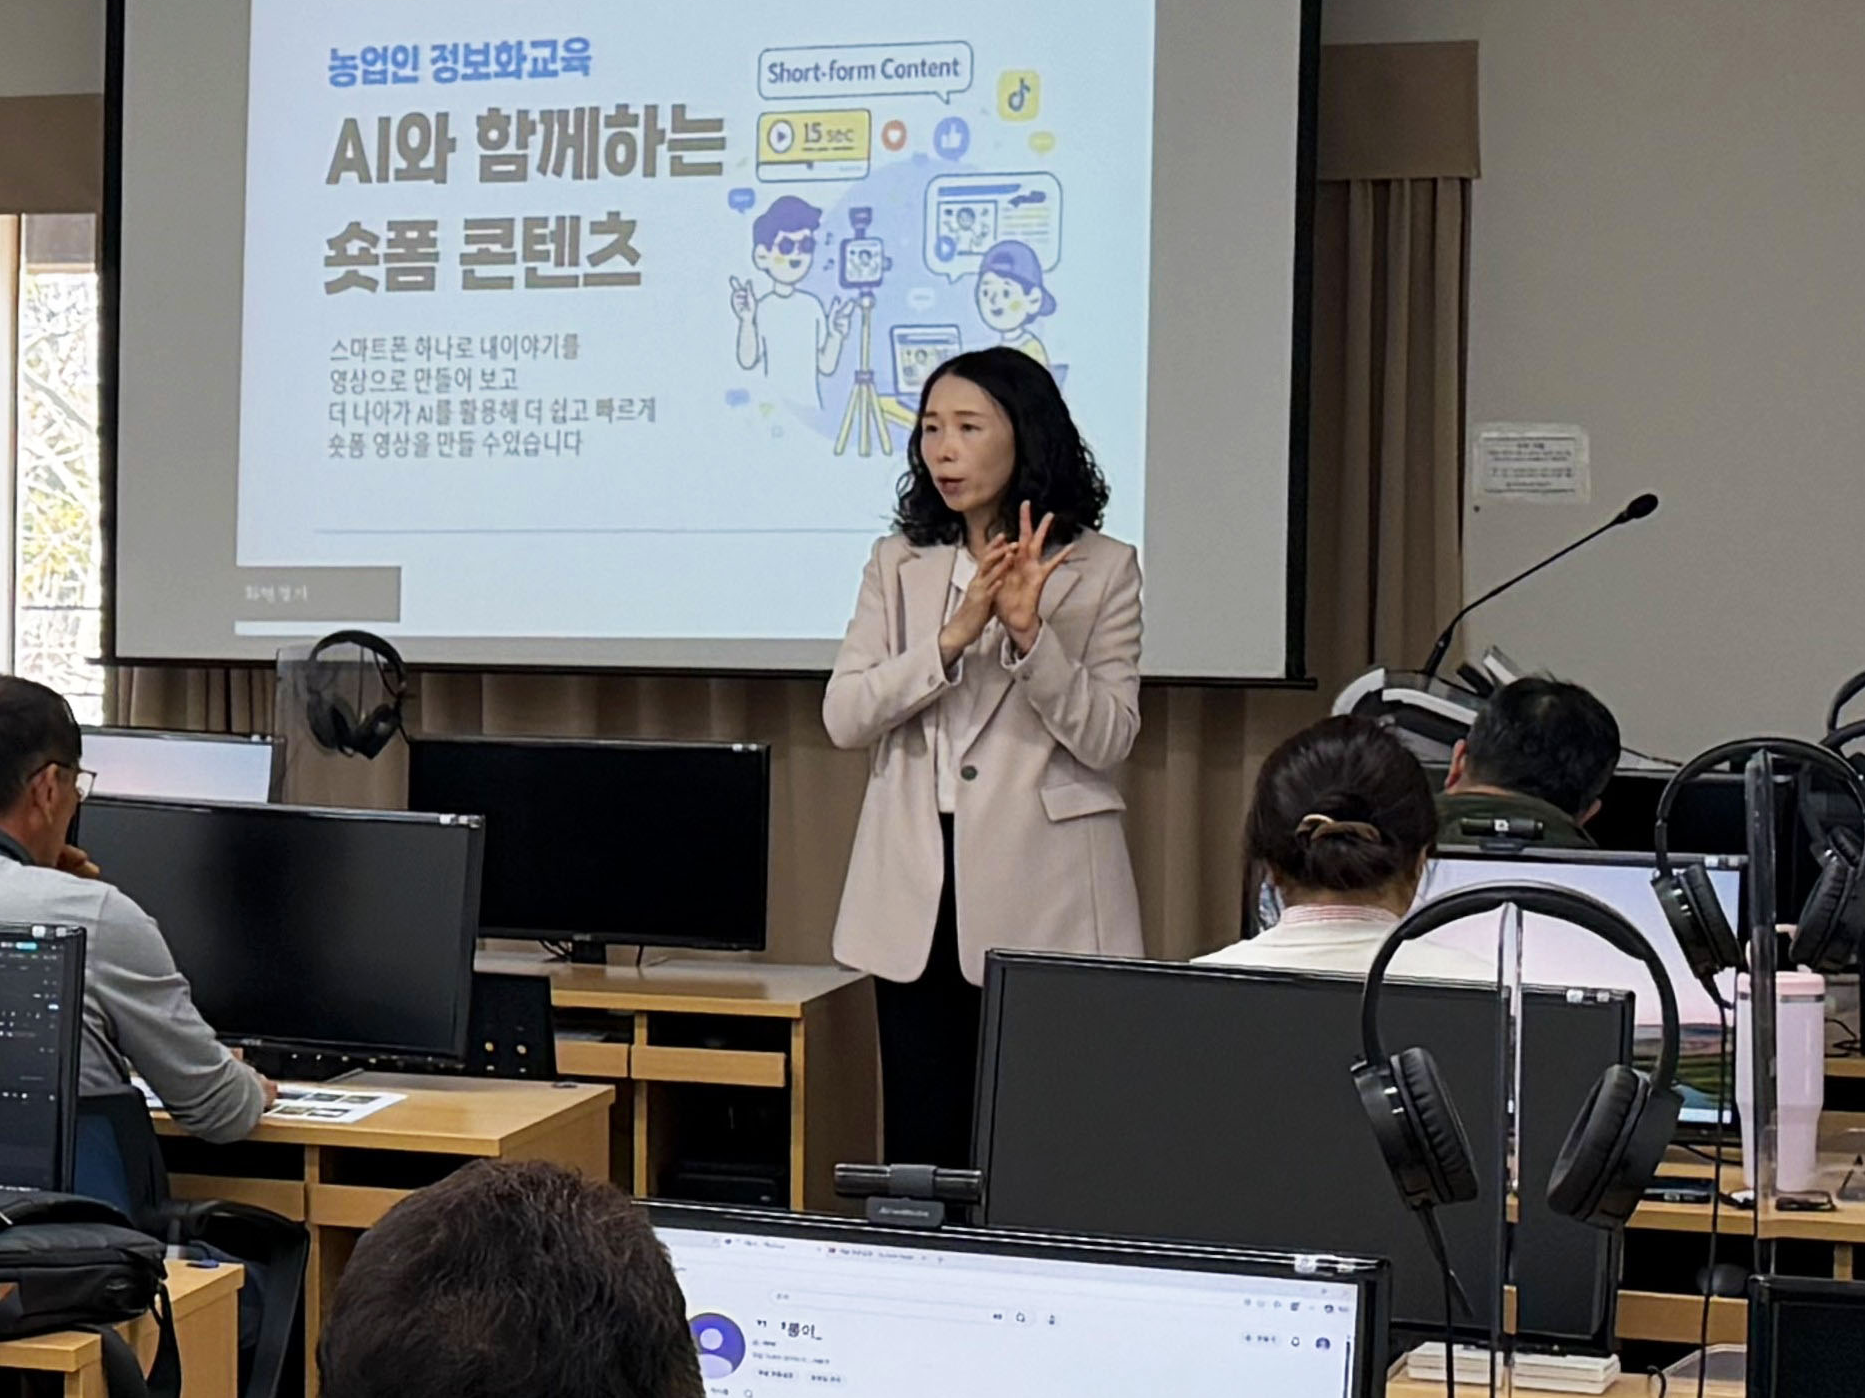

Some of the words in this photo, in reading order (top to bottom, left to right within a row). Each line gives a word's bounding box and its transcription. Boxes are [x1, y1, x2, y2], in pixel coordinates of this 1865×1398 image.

[327, 44, 420, 88] 농업인
[429, 36, 593, 84] 정보화교육
[767, 59, 875, 84] Short-form
[881, 56, 961, 80] Content
[325, 111, 458, 185] AI와
[475, 102, 727, 184] 함께하는
[803, 122, 822, 143] 15
[323, 220, 440, 296] 숏폼
[459, 210, 642, 291] 콘텐츠
[329, 335, 409, 362] 스마트폰
[414, 334, 475, 361] 하나로
[479, 332, 580, 361] 내이야기를
[329, 369, 408, 395] 영상으로
[414, 367, 473, 394] 만들어
[479, 368, 520, 391] 보고
[328, 401, 347, 427] 더
[352, 399, 412, 427] 나아가
[416, 399, 452, 426] AI를
[458, 398, 519, 425] 활용해
[524, 398, 543, 425] 더
[549, 397, 590, 424] 쉽고
[595, 396, 657, 424] 빠르게
[328, 432, 366, 459] 숏폼
[372, 431, 431, 459] 영상을
[436, 431, 476, 458] 만들
[481, 429, 583, 457] 수있습니다
